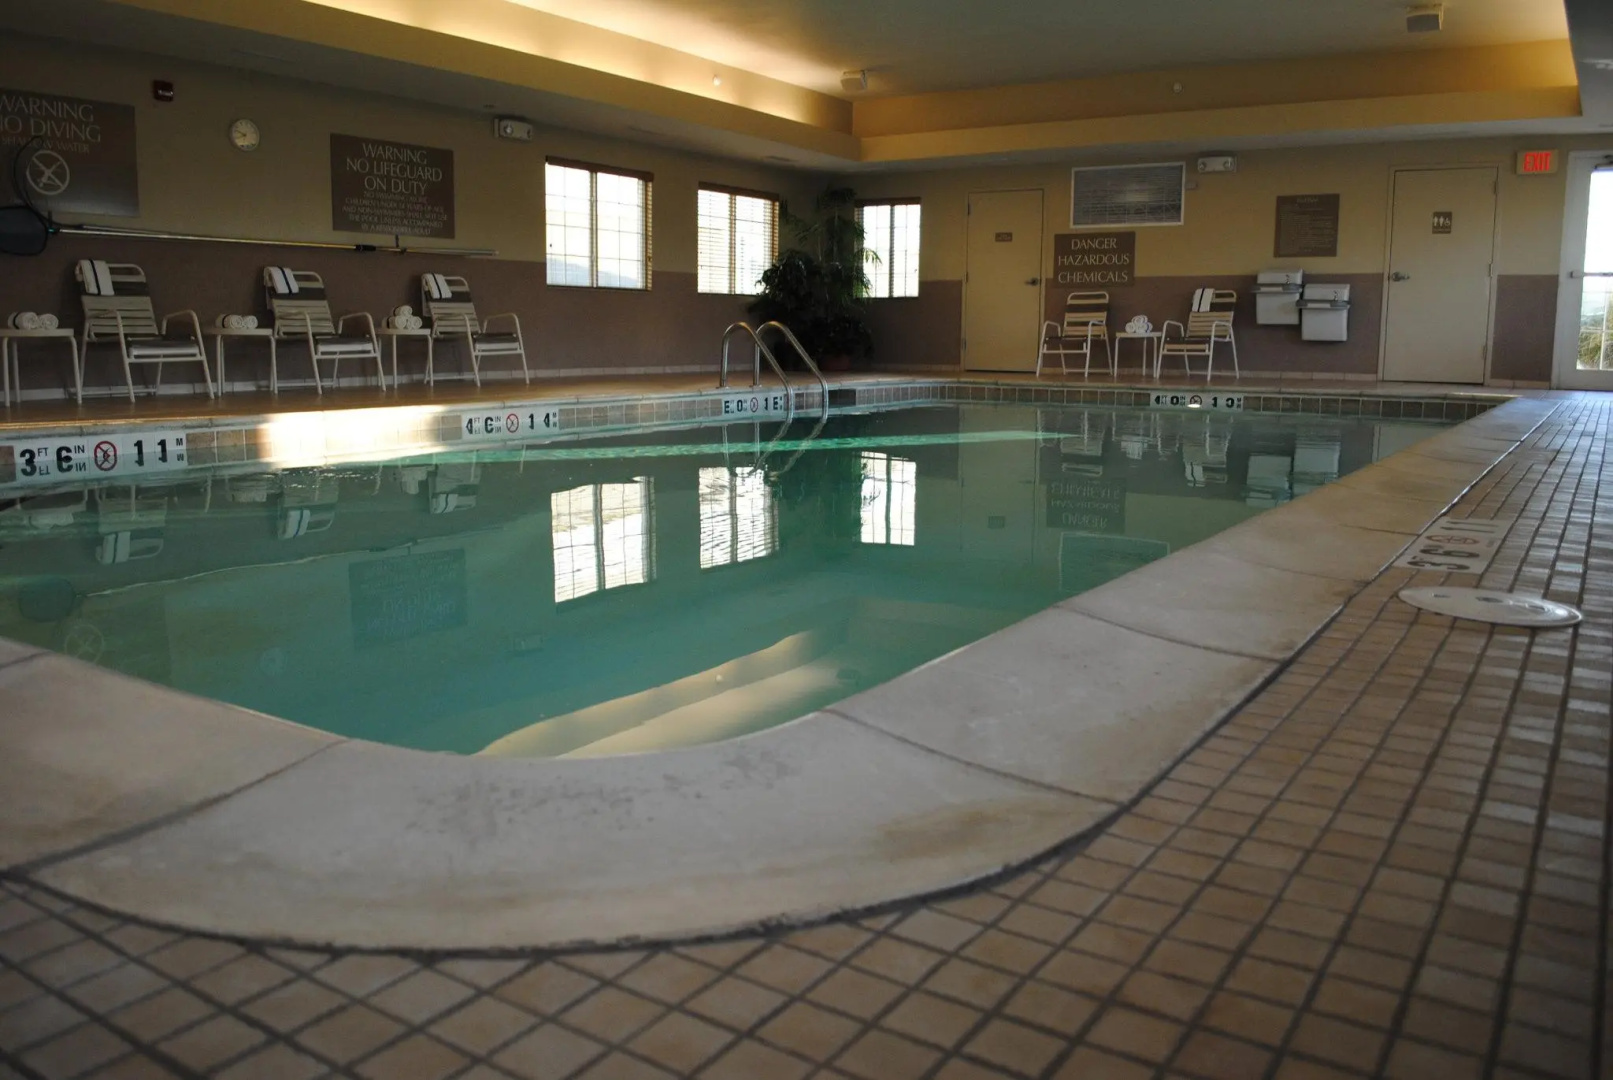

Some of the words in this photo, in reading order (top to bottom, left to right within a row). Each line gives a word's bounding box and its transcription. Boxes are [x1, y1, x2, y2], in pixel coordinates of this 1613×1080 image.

[0, 94, 94, 122] WARNING
[30, 117, 101, 142] DIVING
[362, 143, 427, 165] WARNING
[1524, 151, 1551, 171] EXIT
[346, 157, 369, 173] NO
[374, 160, 442, 182] LIFEGUARD
[364, 176, 387, 192] ON
[391, 179, 427, 195] DUTY
[1071, 237, 1117, 250] DANGER
[1058, 253, 1130, 266] HAZARDOUS
[1058, 269, 1128, 284] CHEMICALS
[38, 447, 48, 457] FT
[74, 445, 85, 454] IN
[176, 438, 183, 446] M
